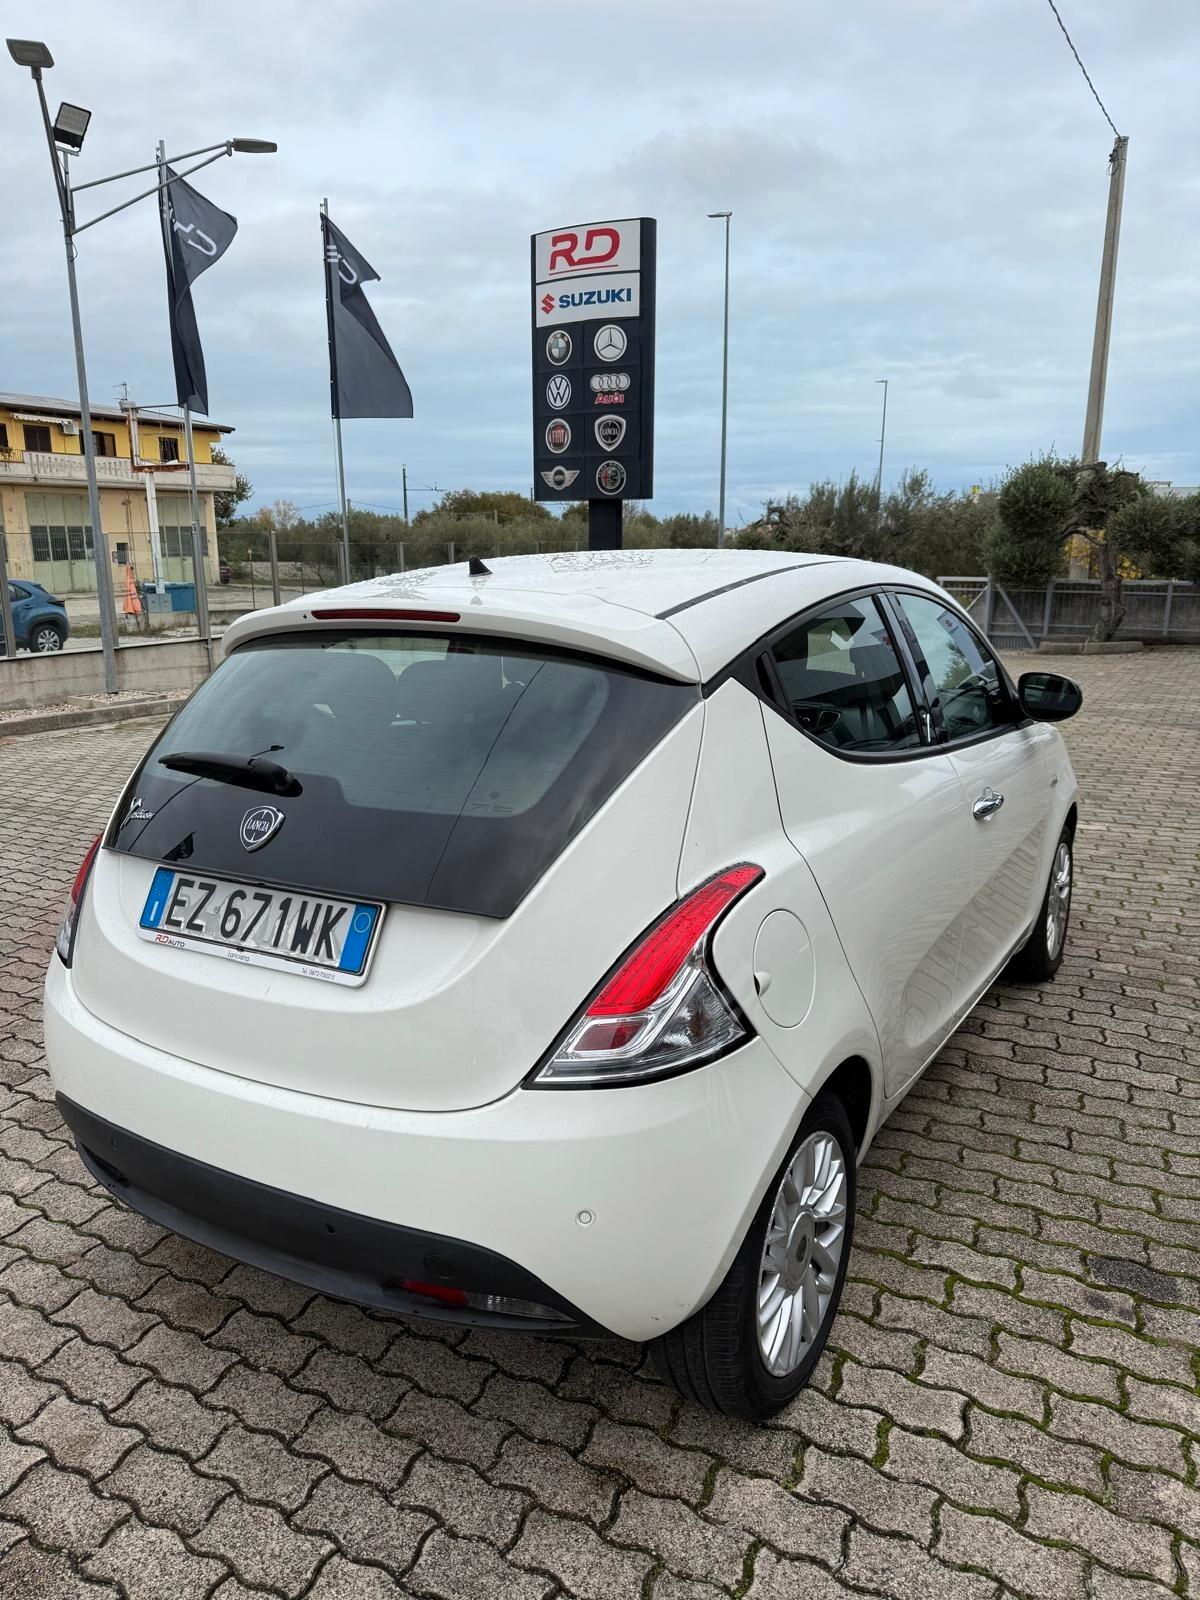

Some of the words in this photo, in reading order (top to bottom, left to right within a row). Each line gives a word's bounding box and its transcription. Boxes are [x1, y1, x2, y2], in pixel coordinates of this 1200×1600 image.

[549, 228, 620, 270] RD
[559, 288, 632, 309] SUZUKI
[594, 392, 625, 405] Audi
[246, 819, 270, 832] LANCIA
[164, 878, 217, 932] EZ
[219, 889, 348, 960] 671WK
[168, 939, 186, 948] AUTO
